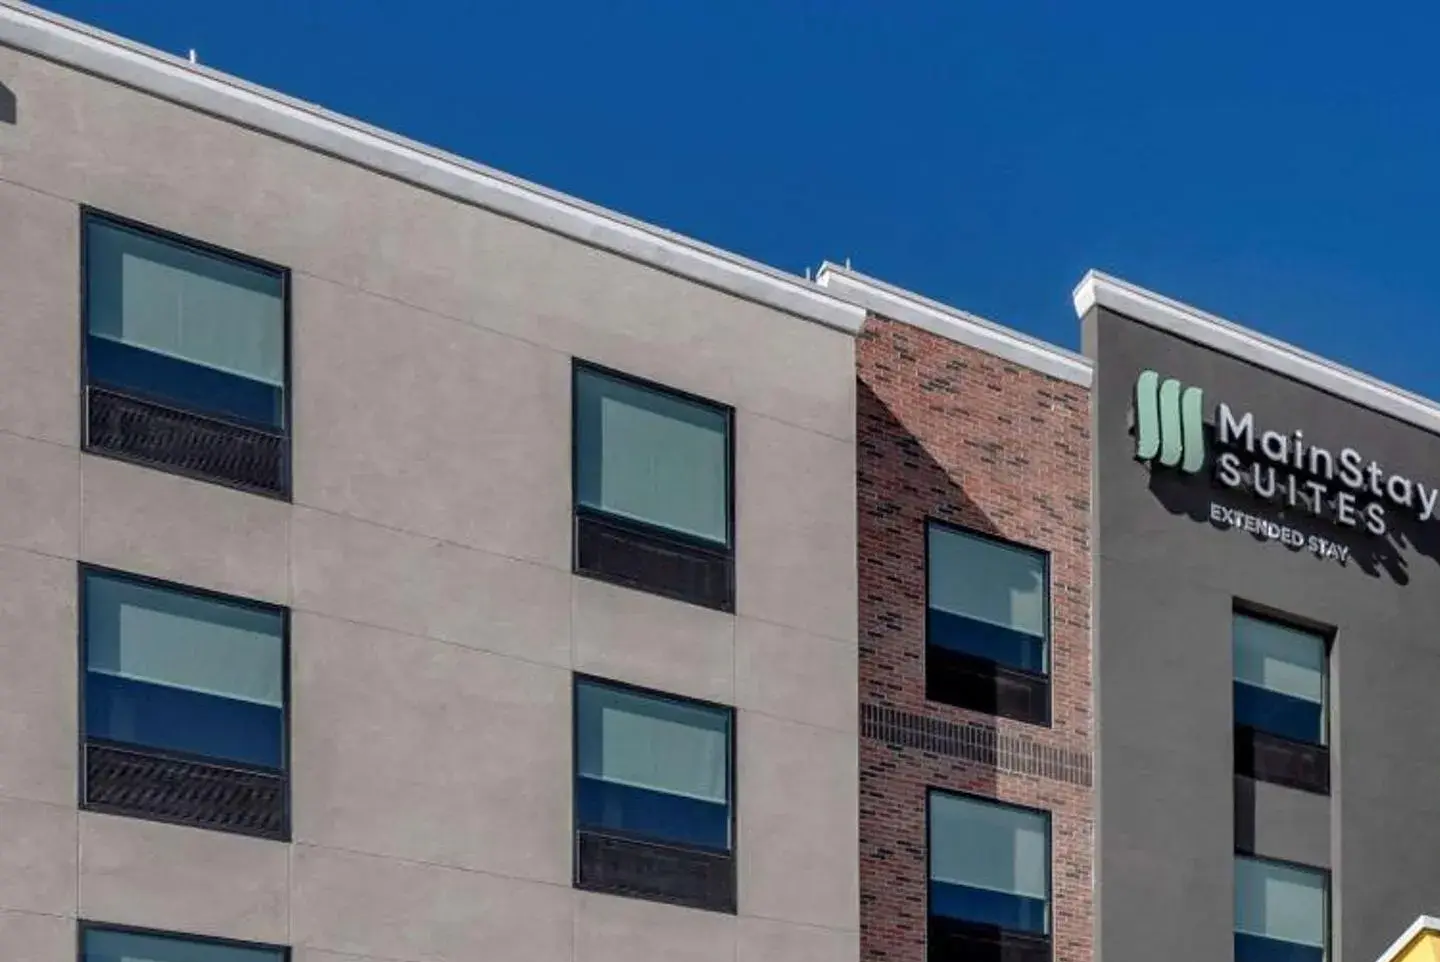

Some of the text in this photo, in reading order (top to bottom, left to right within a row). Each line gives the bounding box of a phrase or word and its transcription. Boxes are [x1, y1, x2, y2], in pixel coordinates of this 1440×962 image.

[1218, 402, 1439, 521] MainStay
[1219, 453, 1387, 536] SUITES
[1210, 502, 1349, 561] EXTENDED STAY
